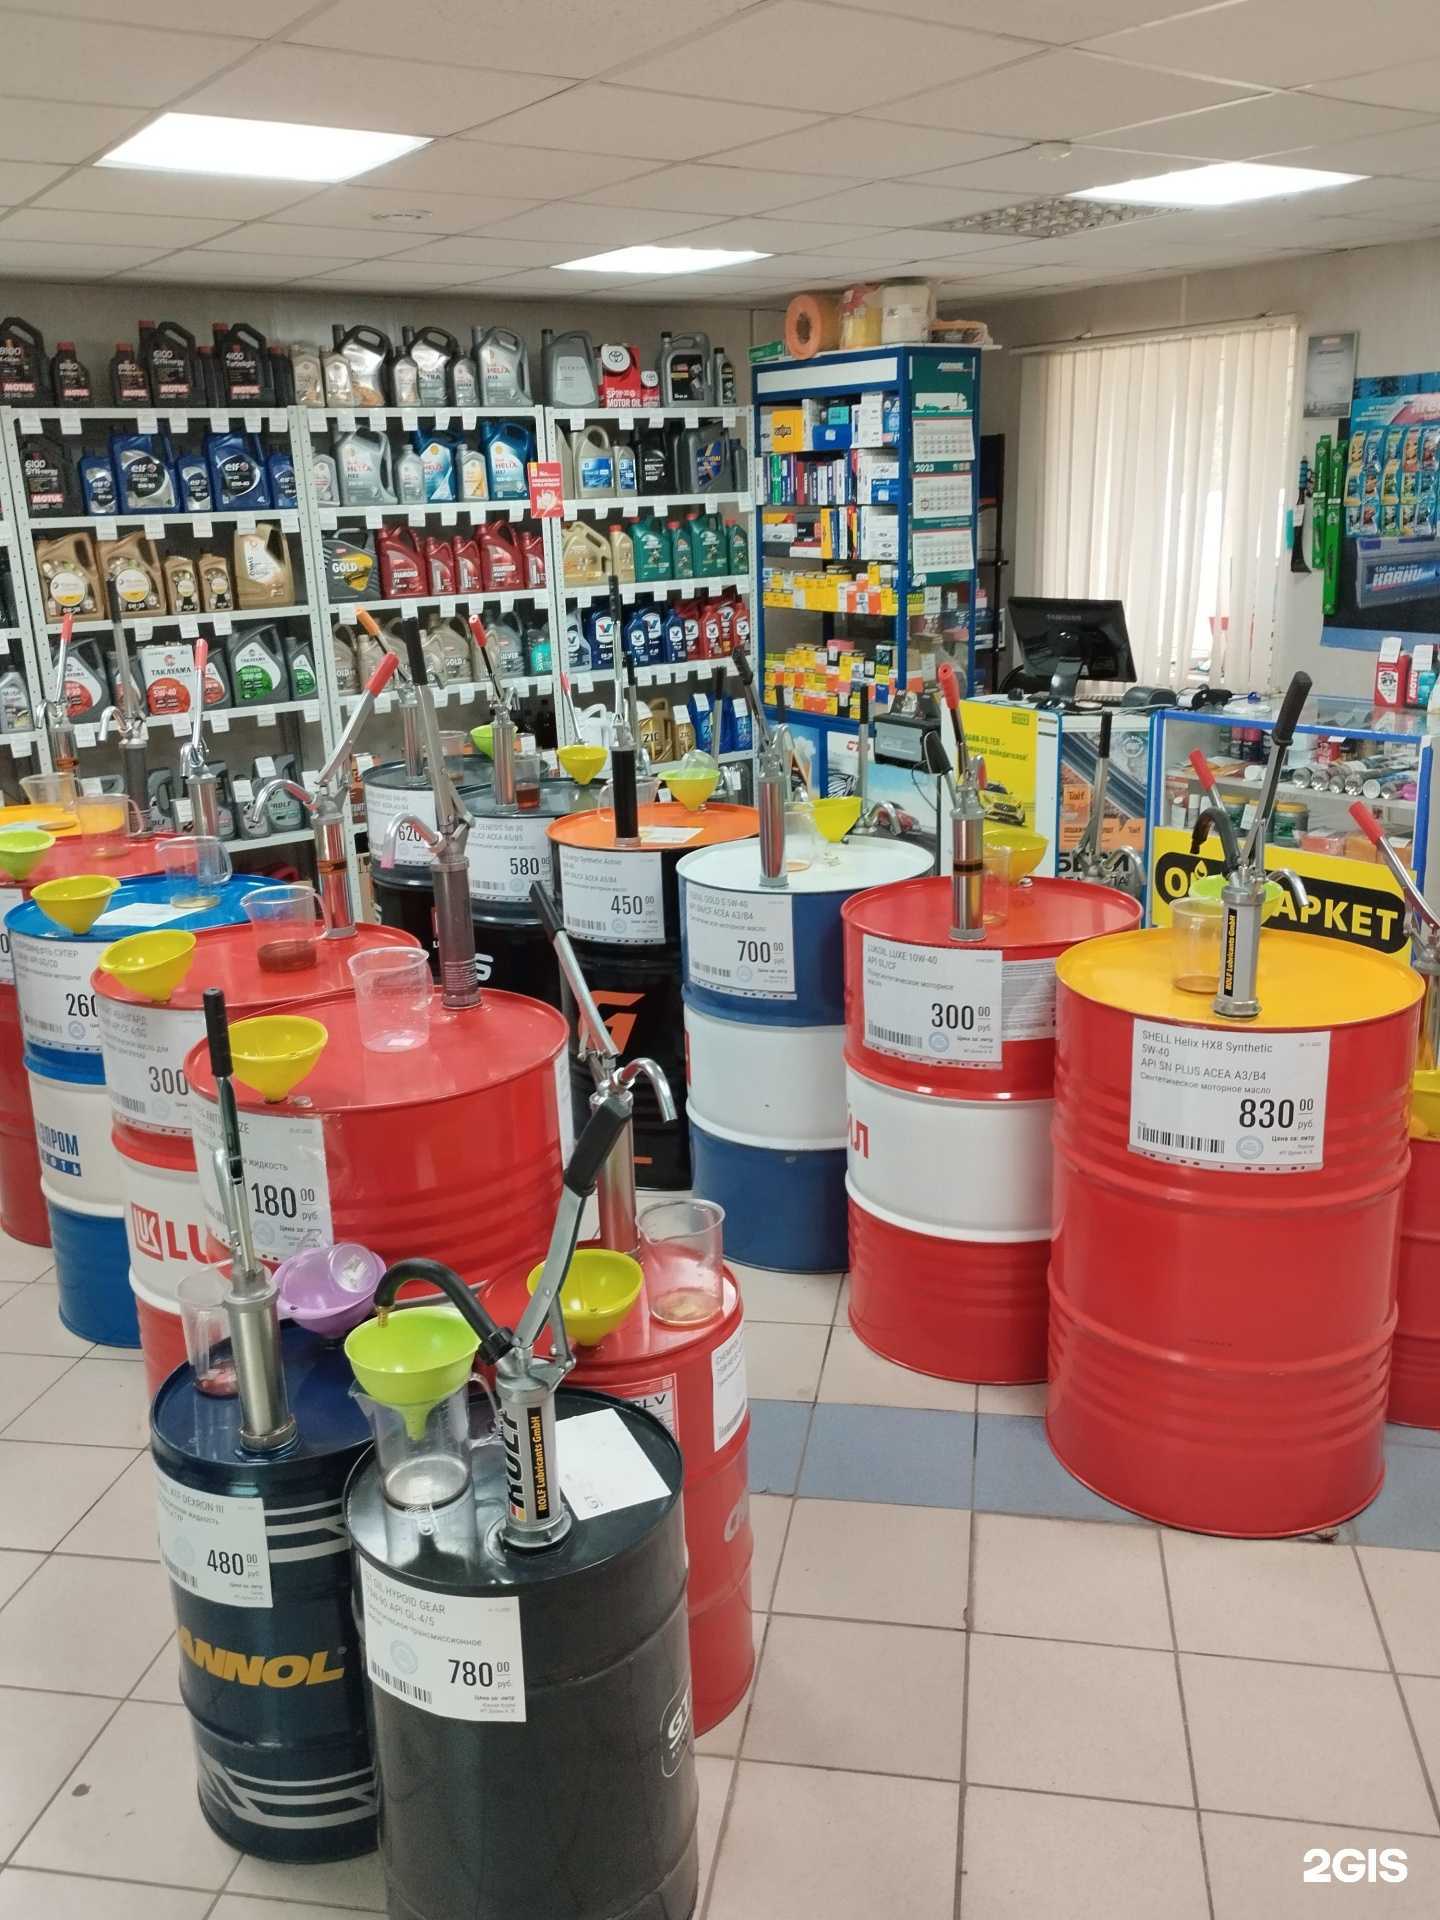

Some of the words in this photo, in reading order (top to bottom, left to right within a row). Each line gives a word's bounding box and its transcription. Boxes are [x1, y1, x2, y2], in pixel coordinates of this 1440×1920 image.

[4, 383, 35, 392] MOTUL
[160, 384, 189, 393] MOTUL
[232, 386, 260, 394] MOTUL
[608, 399, 631, 408] MOTOR
[131, 464, 147, 473] elf
[225, 462, 240, 472] elf
[916, 464, 935, 474] 2023
[32, 494, 64, 503] MOTUL
[332, 562, 358, 573] GOLD
[151, 666, 191, 676] TAKAYAMA
[644, 733, 658, 743] ZIC
[510, 858, 539, 875] 580
[611, 896, 643, 915] 450
[738, 940, 771, 963] 700
[931, 1003, 975, 1030] 300
[978, 1006, 991, 1017] 00
[1142, 1030, 1172, 1045] SHELL
[1174, 1037, 1198, 1049] Helix
[1202, 1040, 1223, 1050] HX8
[1226, 1042, 1273, 1055] Synthetic
[1140, 1058, 1157, 1070] API
[1160, 1061, 1172, 1072] SN
[1175, 1064, 1201, 1076] PLUS
[1203, 1066, 1231, 1079] ACEA
[1234, 1071, 1267, 1082] A3/B4
[149, 1066, 189, 1096] 300
[1201, 1083, 1242, 1096] моторное
[1244, 1086, 1272, 1095] масло
[1240, 1098, 1295, 1129] 830
[1300, 1098, 1314, 1112] 00
[1298, 1120, 1313, 1130] руб
[251, 1182, 297, 1219] 180
[300, 1188, 315, 1202] 00
[530, 1416, 542, 1442] GmbH
[534, 1442, 546, 1490] Lubricants
[538, 1489, 548, 1512] ROLF
[207, 1550, 244, 1576] 480
[247, 1554, 258, 1565] 00
[419, 1600, 446, 1615] GEAR
[448, 1659, 493, 1688] 780
[496, 1662, 510, 1673] 00
